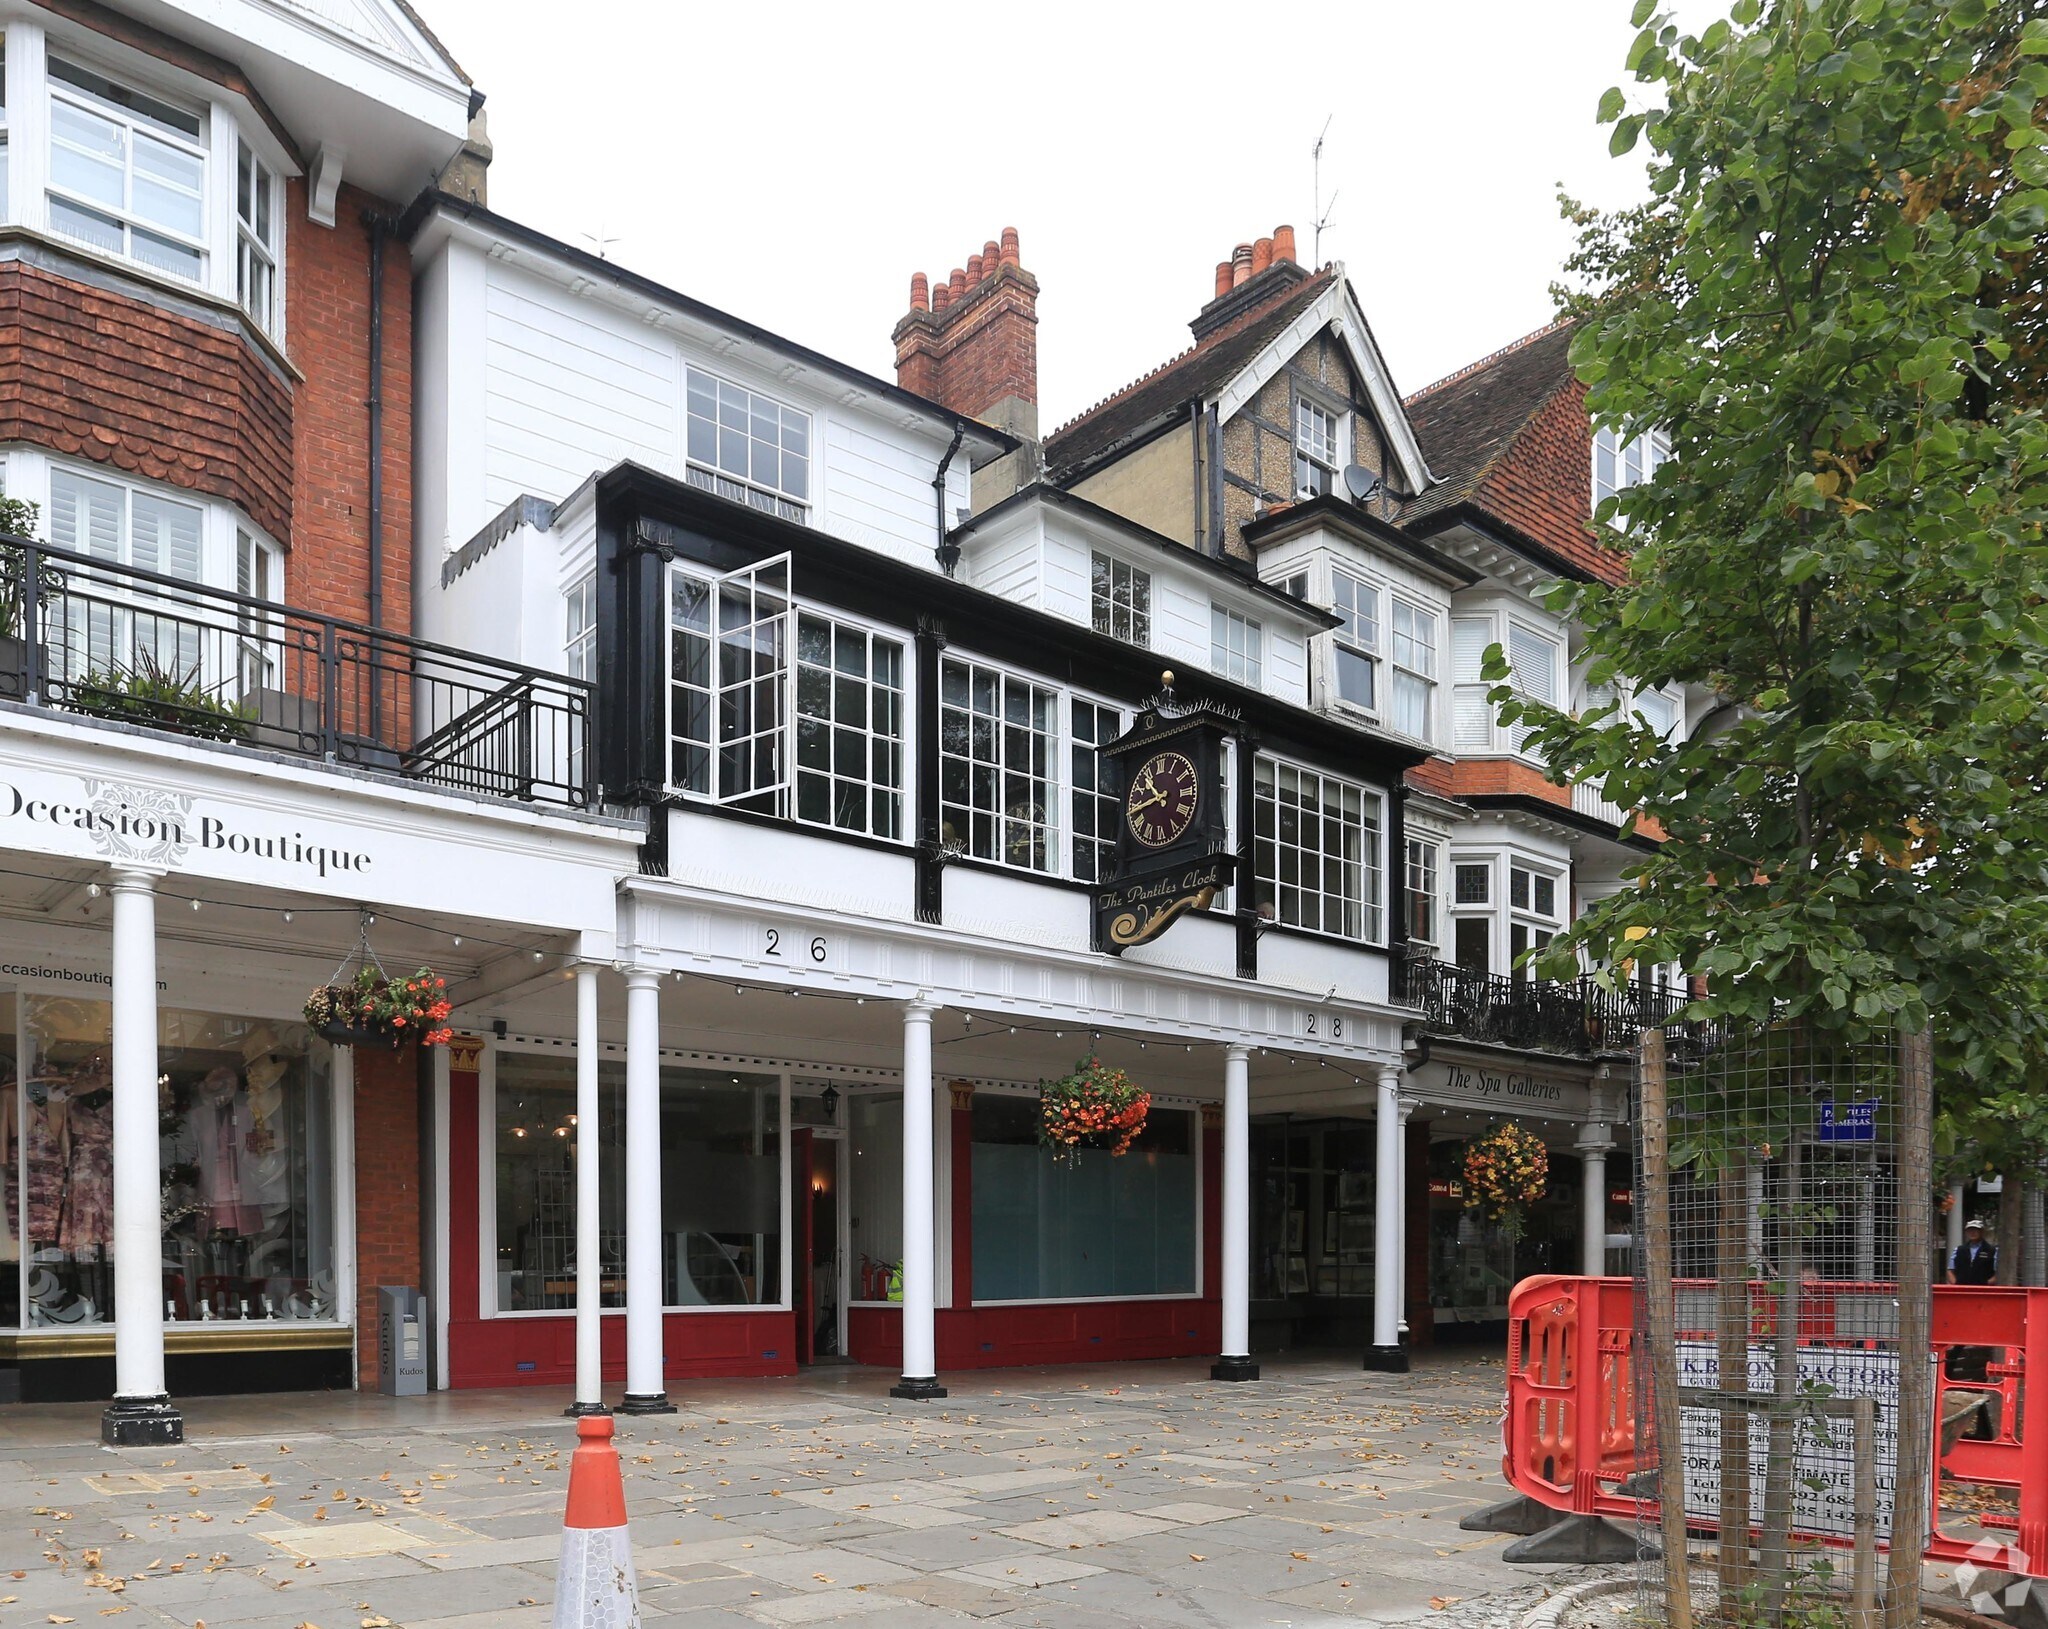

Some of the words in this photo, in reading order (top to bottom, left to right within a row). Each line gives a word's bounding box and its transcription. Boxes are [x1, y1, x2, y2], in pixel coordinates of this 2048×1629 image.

[199, 816, 372, 877] Boutique
[1099, 891, 1123, 909] The
[1128, 878, 1177, 903] Pantiles
[1182, 865, 1217, 889] Clock
[1447, 1065, 1471, 1088] The
[1477, 1069, 1501, 1095] Spa
[1507, 1074, 1561, 1100] Galleries
[382, 1312, 390, 1375] Kudos
[399, 1367, 425, 1376] Kudos
[1680, 1411, 1719, 1423] Fencin
